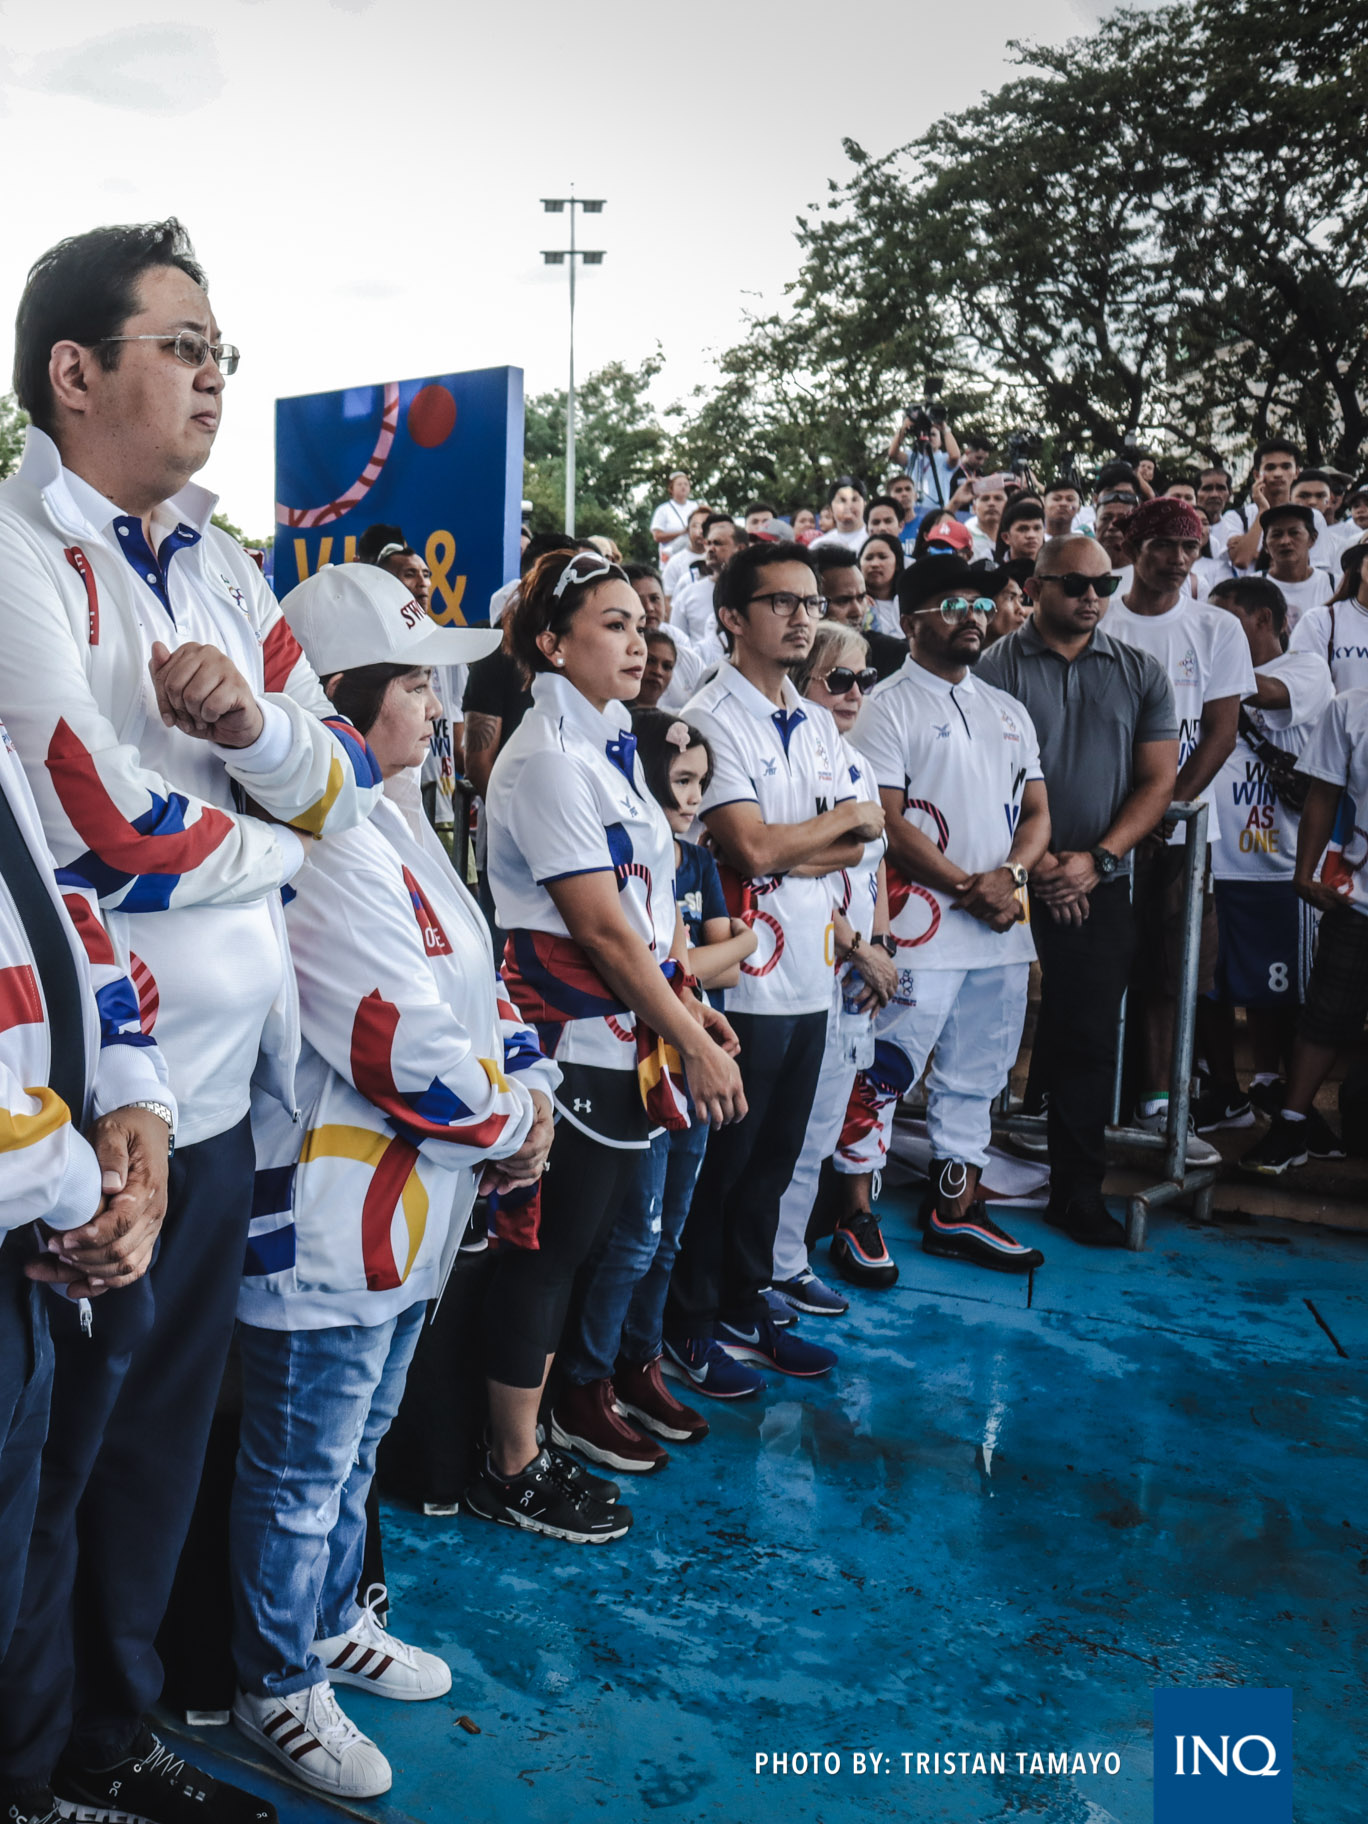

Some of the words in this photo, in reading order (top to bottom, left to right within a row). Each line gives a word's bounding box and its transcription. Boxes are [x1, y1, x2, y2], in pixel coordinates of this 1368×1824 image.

[1232, 781, 1278, 806] WIN
[1245, 805, 1275, 830] AS
[1238, 830, 1280, 853] ONE
[1268, 961, 1289, 992] 8
